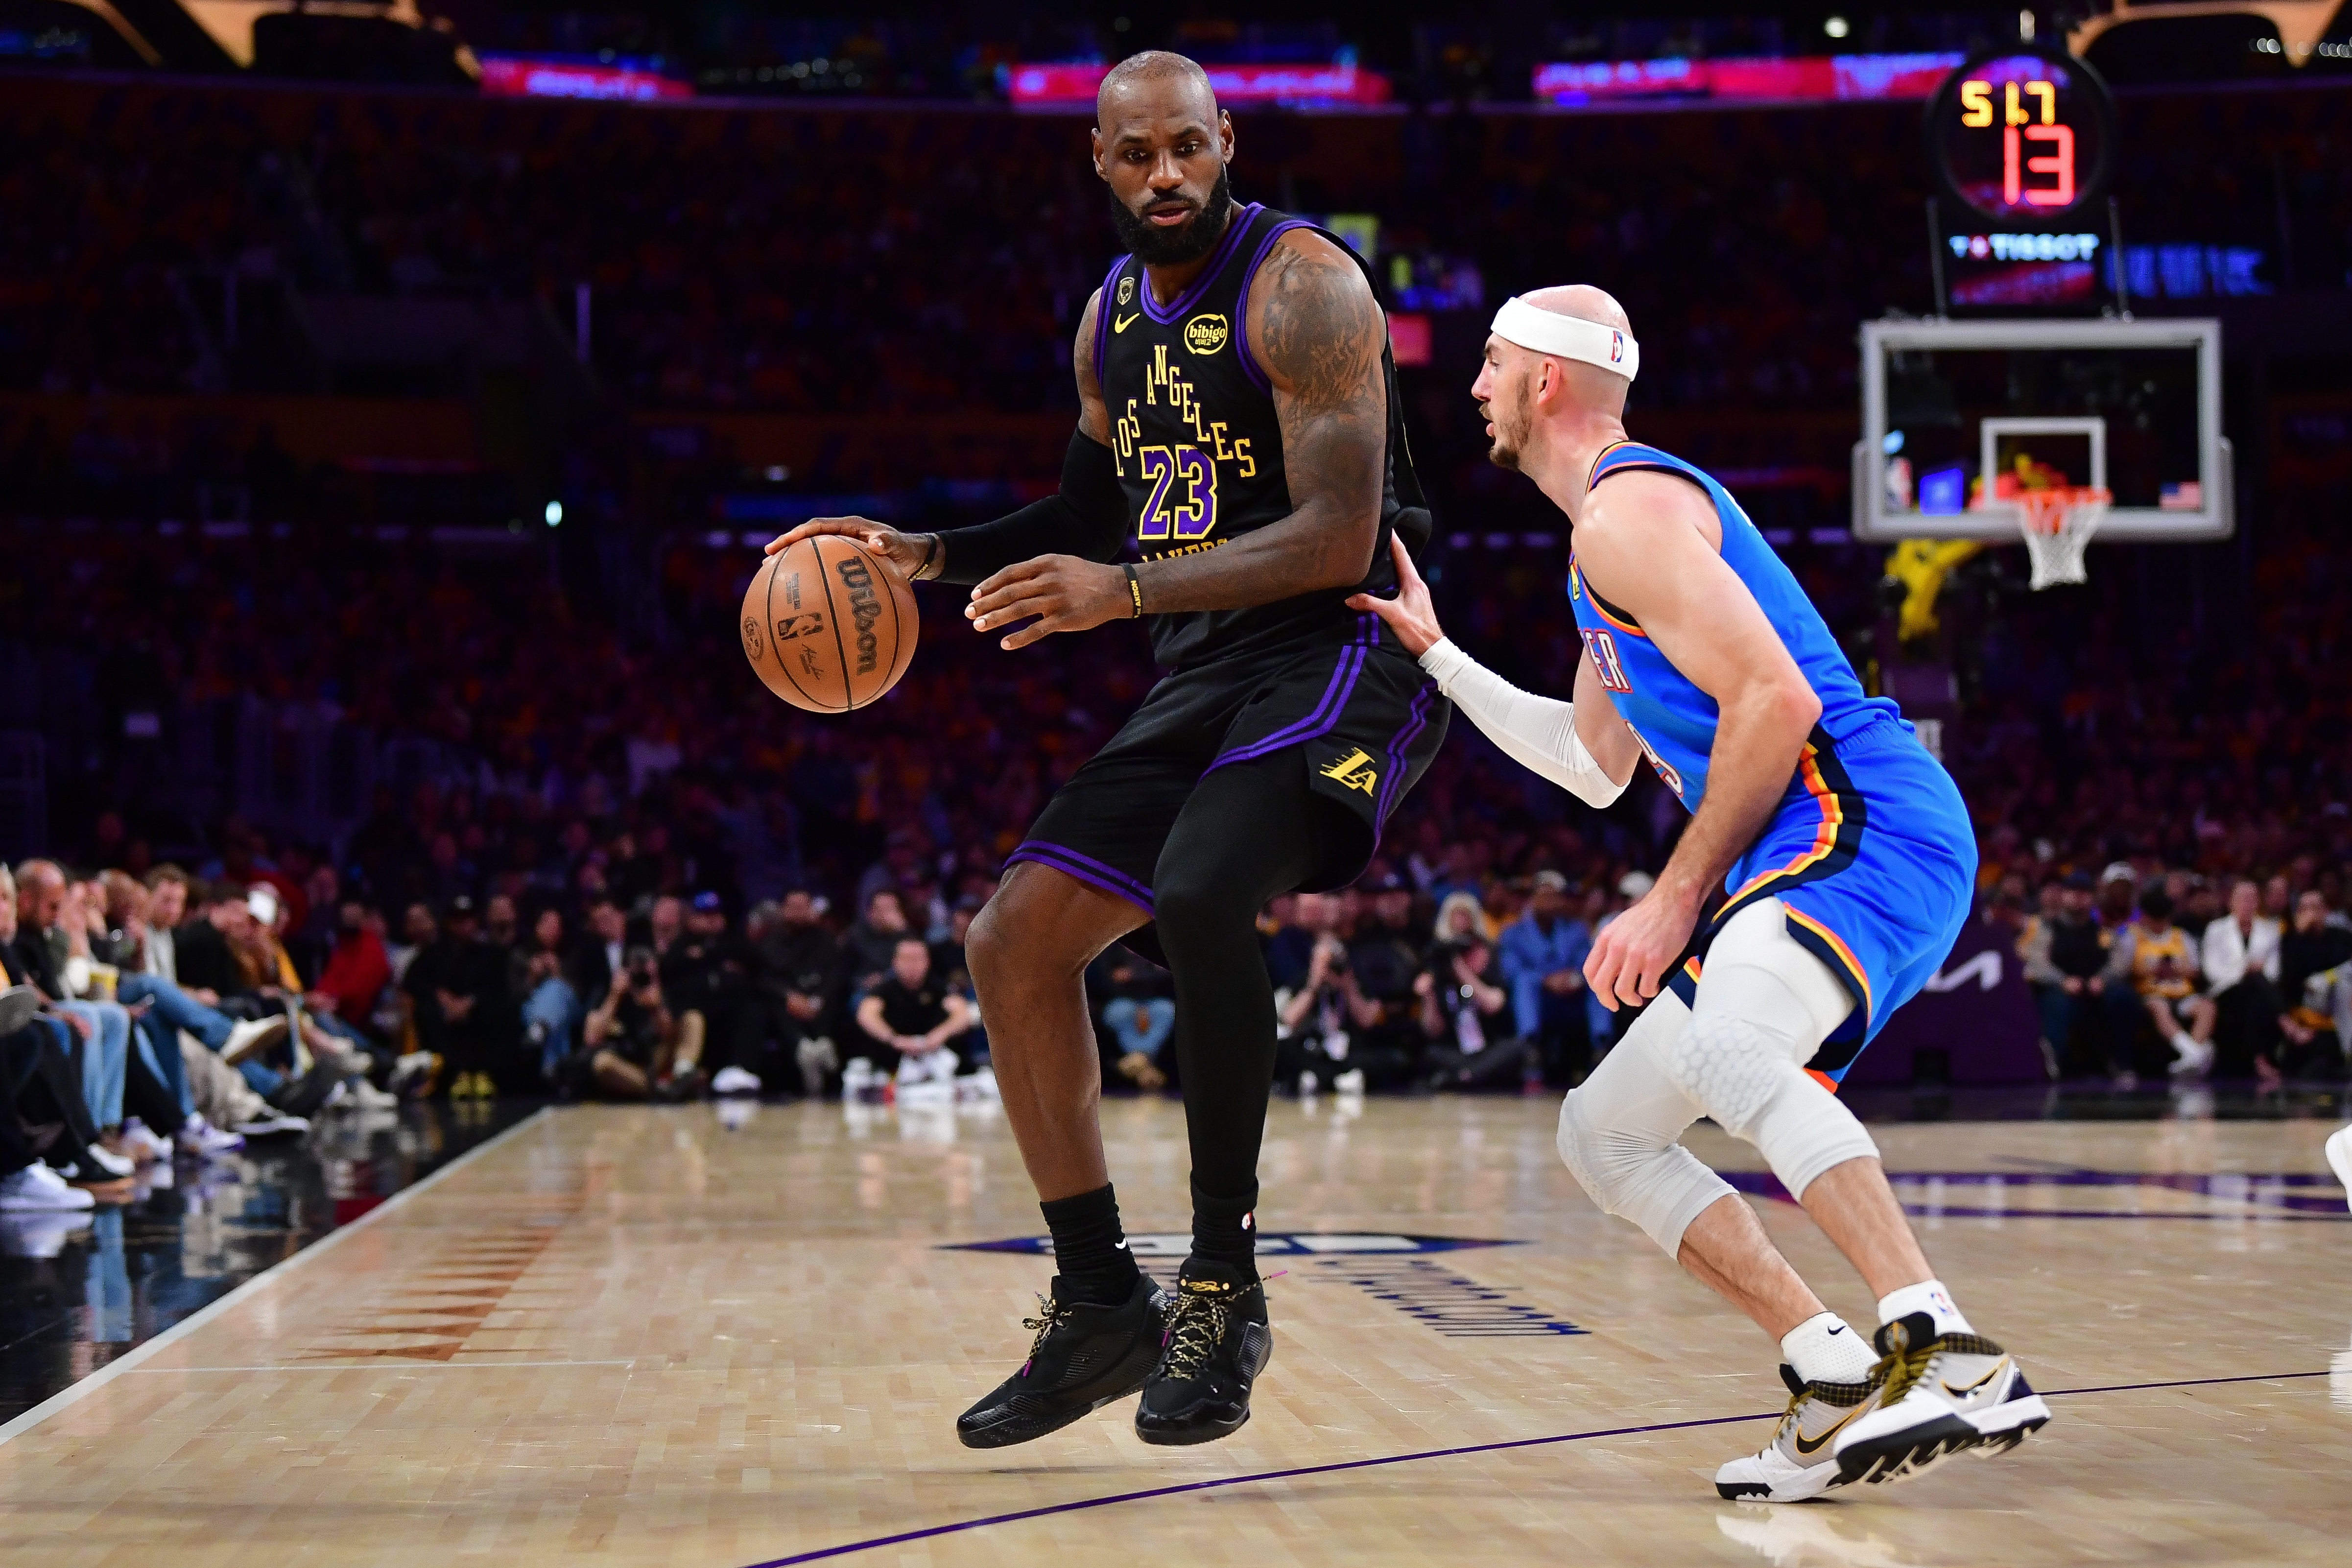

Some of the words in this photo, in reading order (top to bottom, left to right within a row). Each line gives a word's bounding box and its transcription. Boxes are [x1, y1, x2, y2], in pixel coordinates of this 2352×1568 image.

[2003, 124, 2075, 206] 13
[1189, 324, 1226, 343] bibigo
[1112, 398, 1141, 477] LOS
[1146, 344, 1257, 478] ANGELES
[1138, 444, 1218, 540] 23
[836, 555, 881, 676] Wilson
[1130, 580, 1141, 607] AKRON
